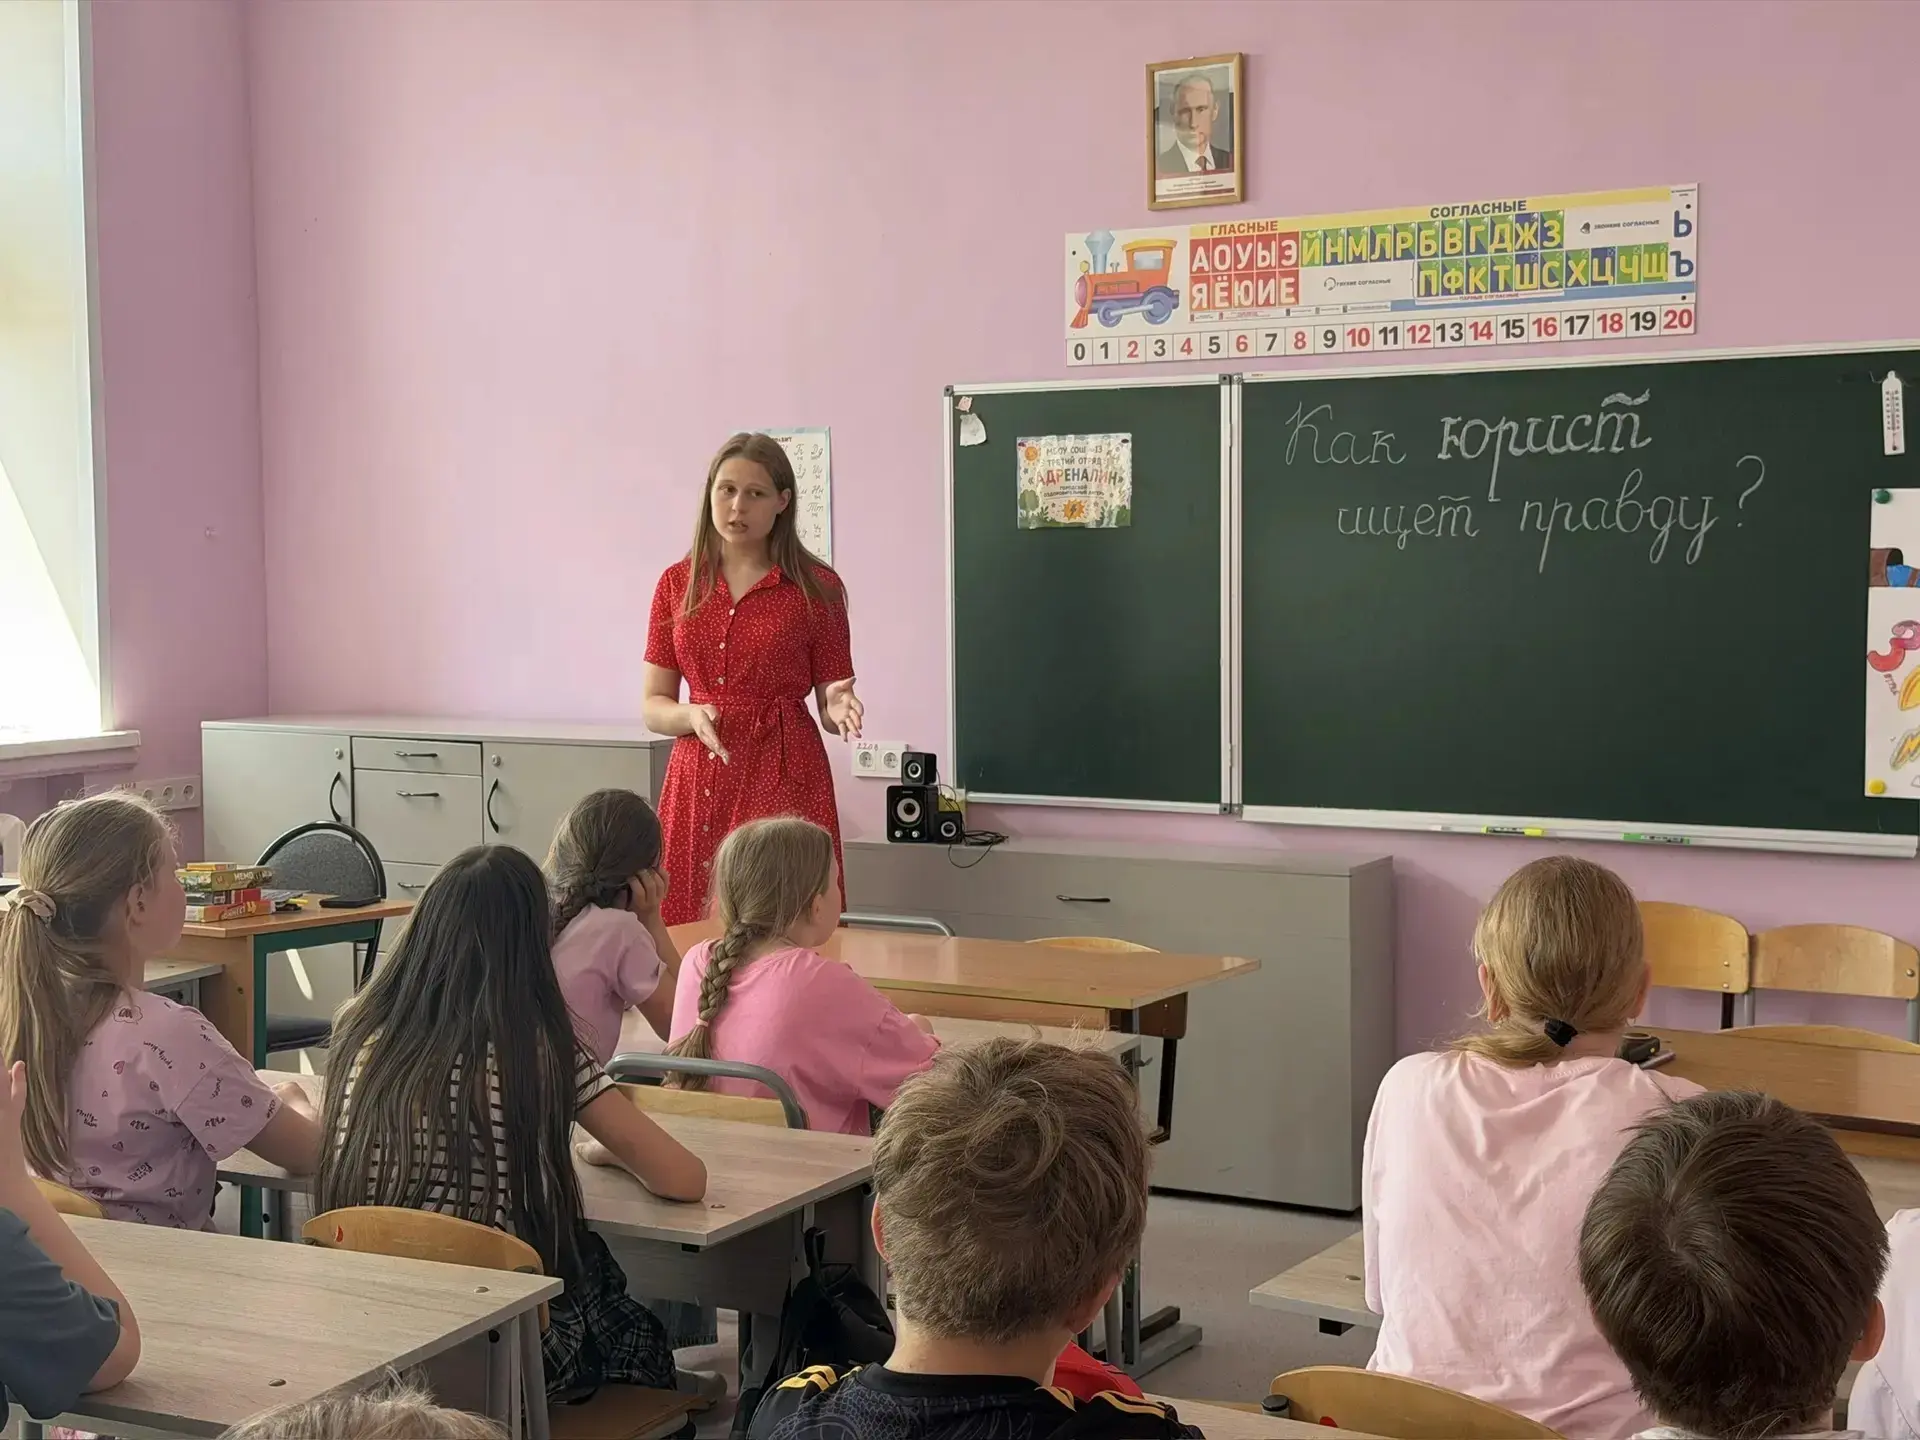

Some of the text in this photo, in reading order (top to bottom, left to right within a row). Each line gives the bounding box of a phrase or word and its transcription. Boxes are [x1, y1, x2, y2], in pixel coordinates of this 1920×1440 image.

[1430, 200, 1527, 219] СОГЛАСНЫЕ
[1210, 220, 1279, 236] ГЛАСНЫЕ
[1622, 219, 1660, 228] СОГЛАСНЫЕ
[1358, 278, 1391, 286] СОГЛАСНЫЕ
[1074, 308, 1693, 361] 0 1 2 3 4 5 6 7 8 9 10 11 12 13 14 15 16 17 18 19 20
[1284, 401, 1406, 466] Как
[1337, 495, 1480, 550] ищет
